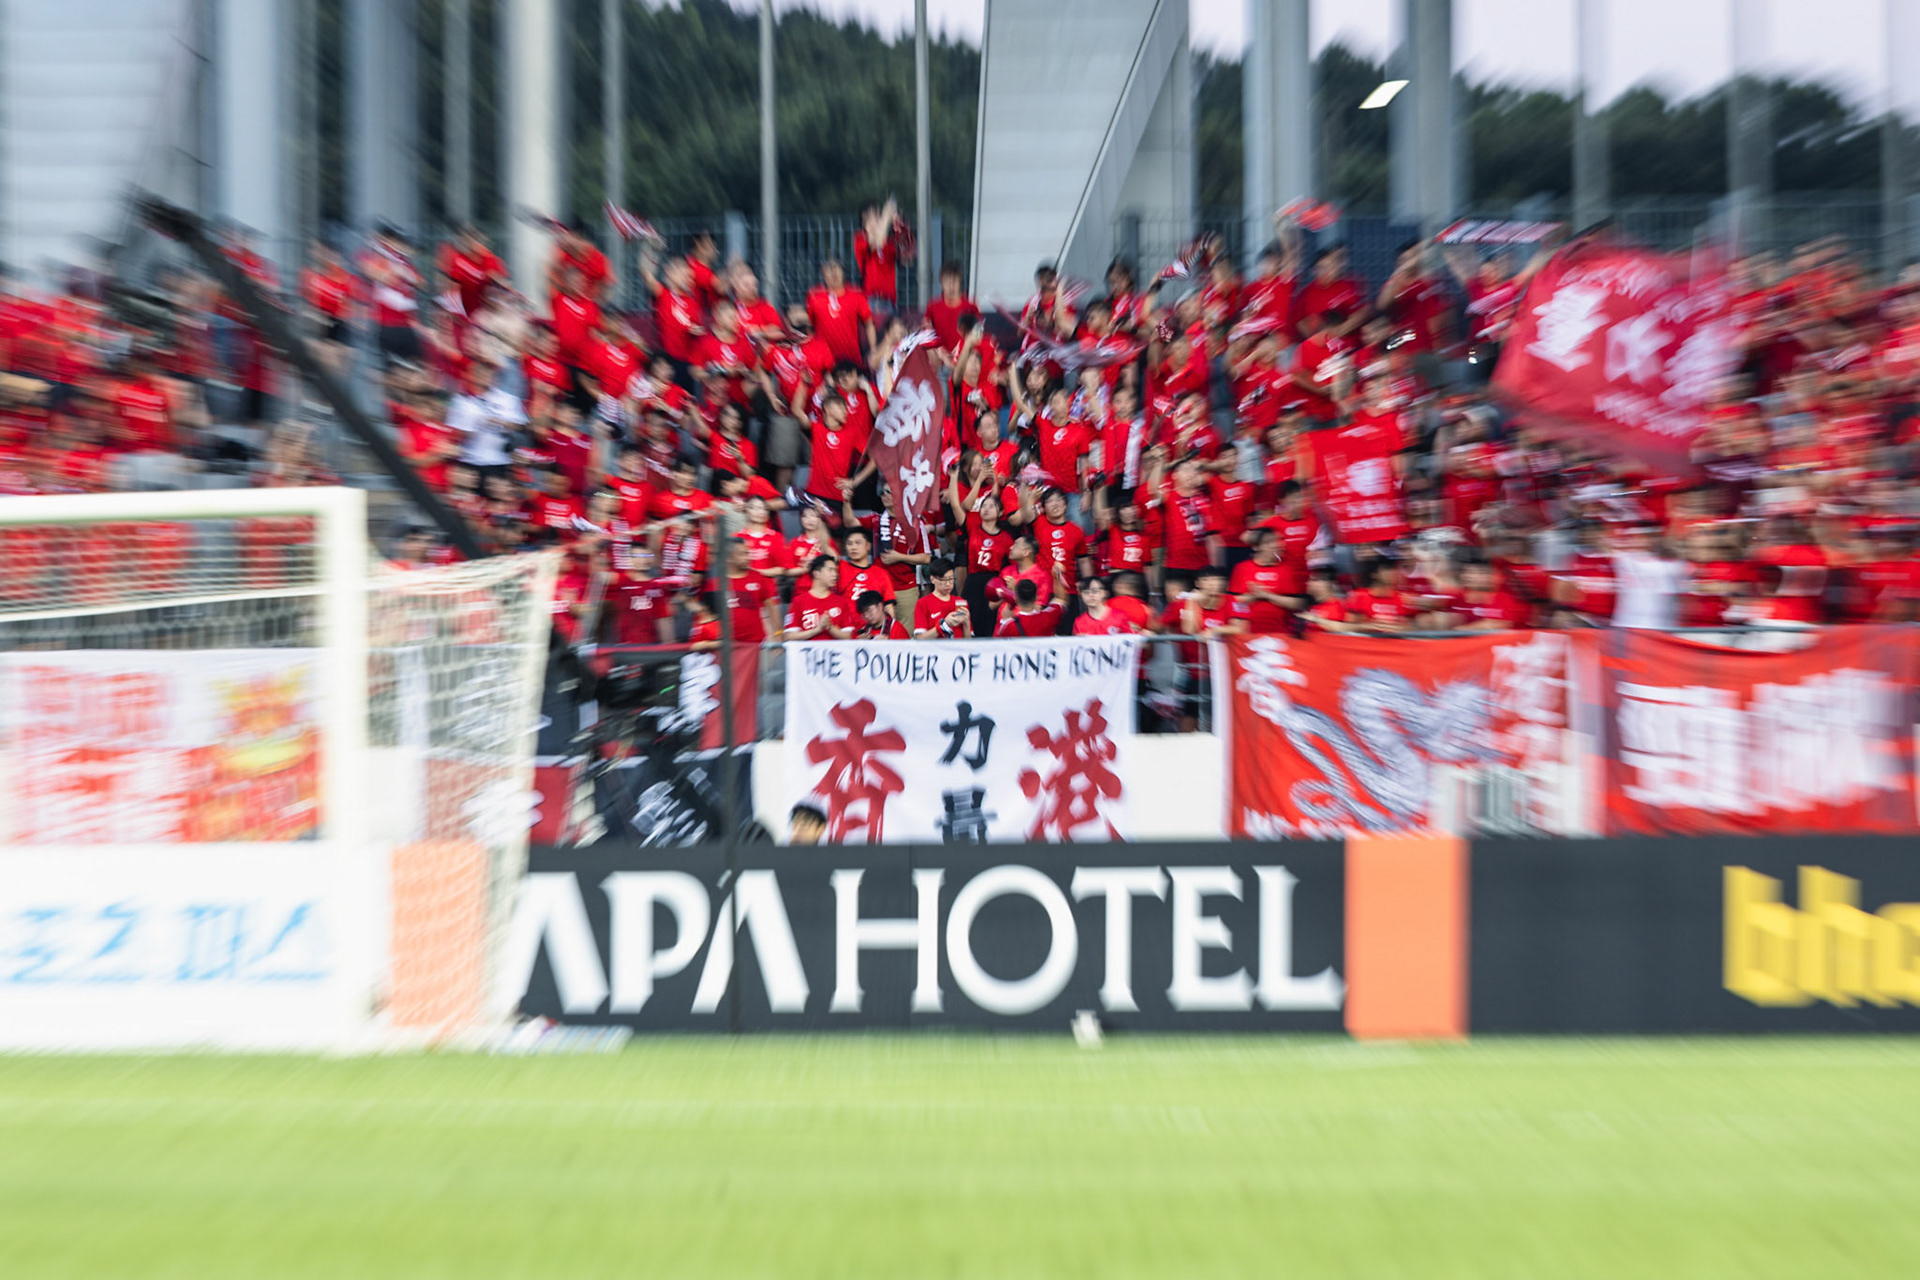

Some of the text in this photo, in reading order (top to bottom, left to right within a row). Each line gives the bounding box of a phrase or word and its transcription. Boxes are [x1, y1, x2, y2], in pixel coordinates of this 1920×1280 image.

[977, 550, 992, 566] 12
[801, 640, 1133, 684] THE POWER OF HONG KONG
[508, 864, 1347, 1014] APA HOTEL
